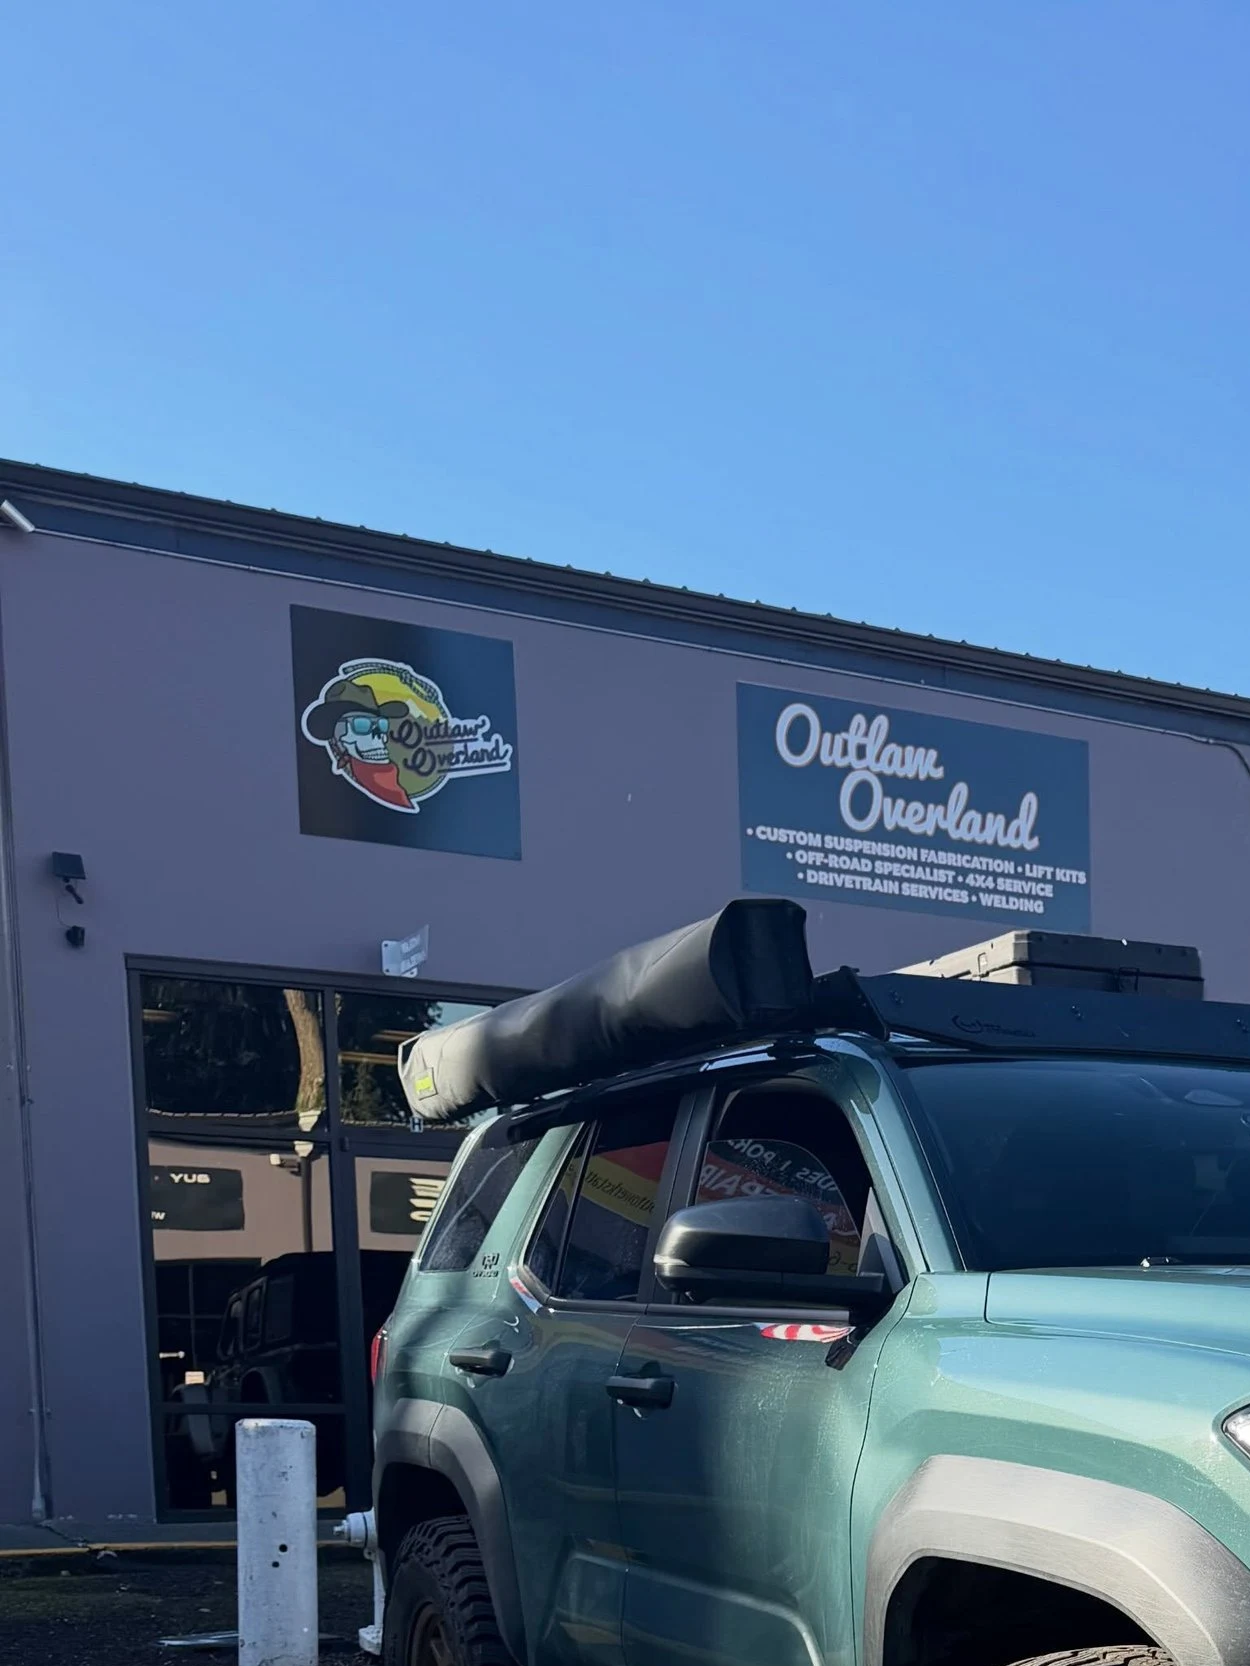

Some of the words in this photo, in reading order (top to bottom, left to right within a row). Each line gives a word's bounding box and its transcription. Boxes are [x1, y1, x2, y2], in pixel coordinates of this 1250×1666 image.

[389, 718, 486, 749] Outlaw
[402, 735, 510, 777] Overland
[775, 702, 945, 780] Outlaw
[839, 769, 1040, 850] Overland
[755, 825, 823, 848] CUSTOM
[823, 834, 919, 861] SUSPENSION
[919, 848, 1016, 875] FABRICATION
[1024, 863, 1054, 881] LIFT
[1054, 867, 1087, 885] KITS
[795, 849, 872, 872] OFF-ROAD
[874, 862, 956, 885] SPECIALIST
[965, 873, 995, 889] 4X4
[995, 878, 1054, 898] SERVICE
[806, 870, 899, 895] DRIVETRAIN
[901, 882, 969, 904] SERVICES
[978, 892, 1044, 914] WELDING
